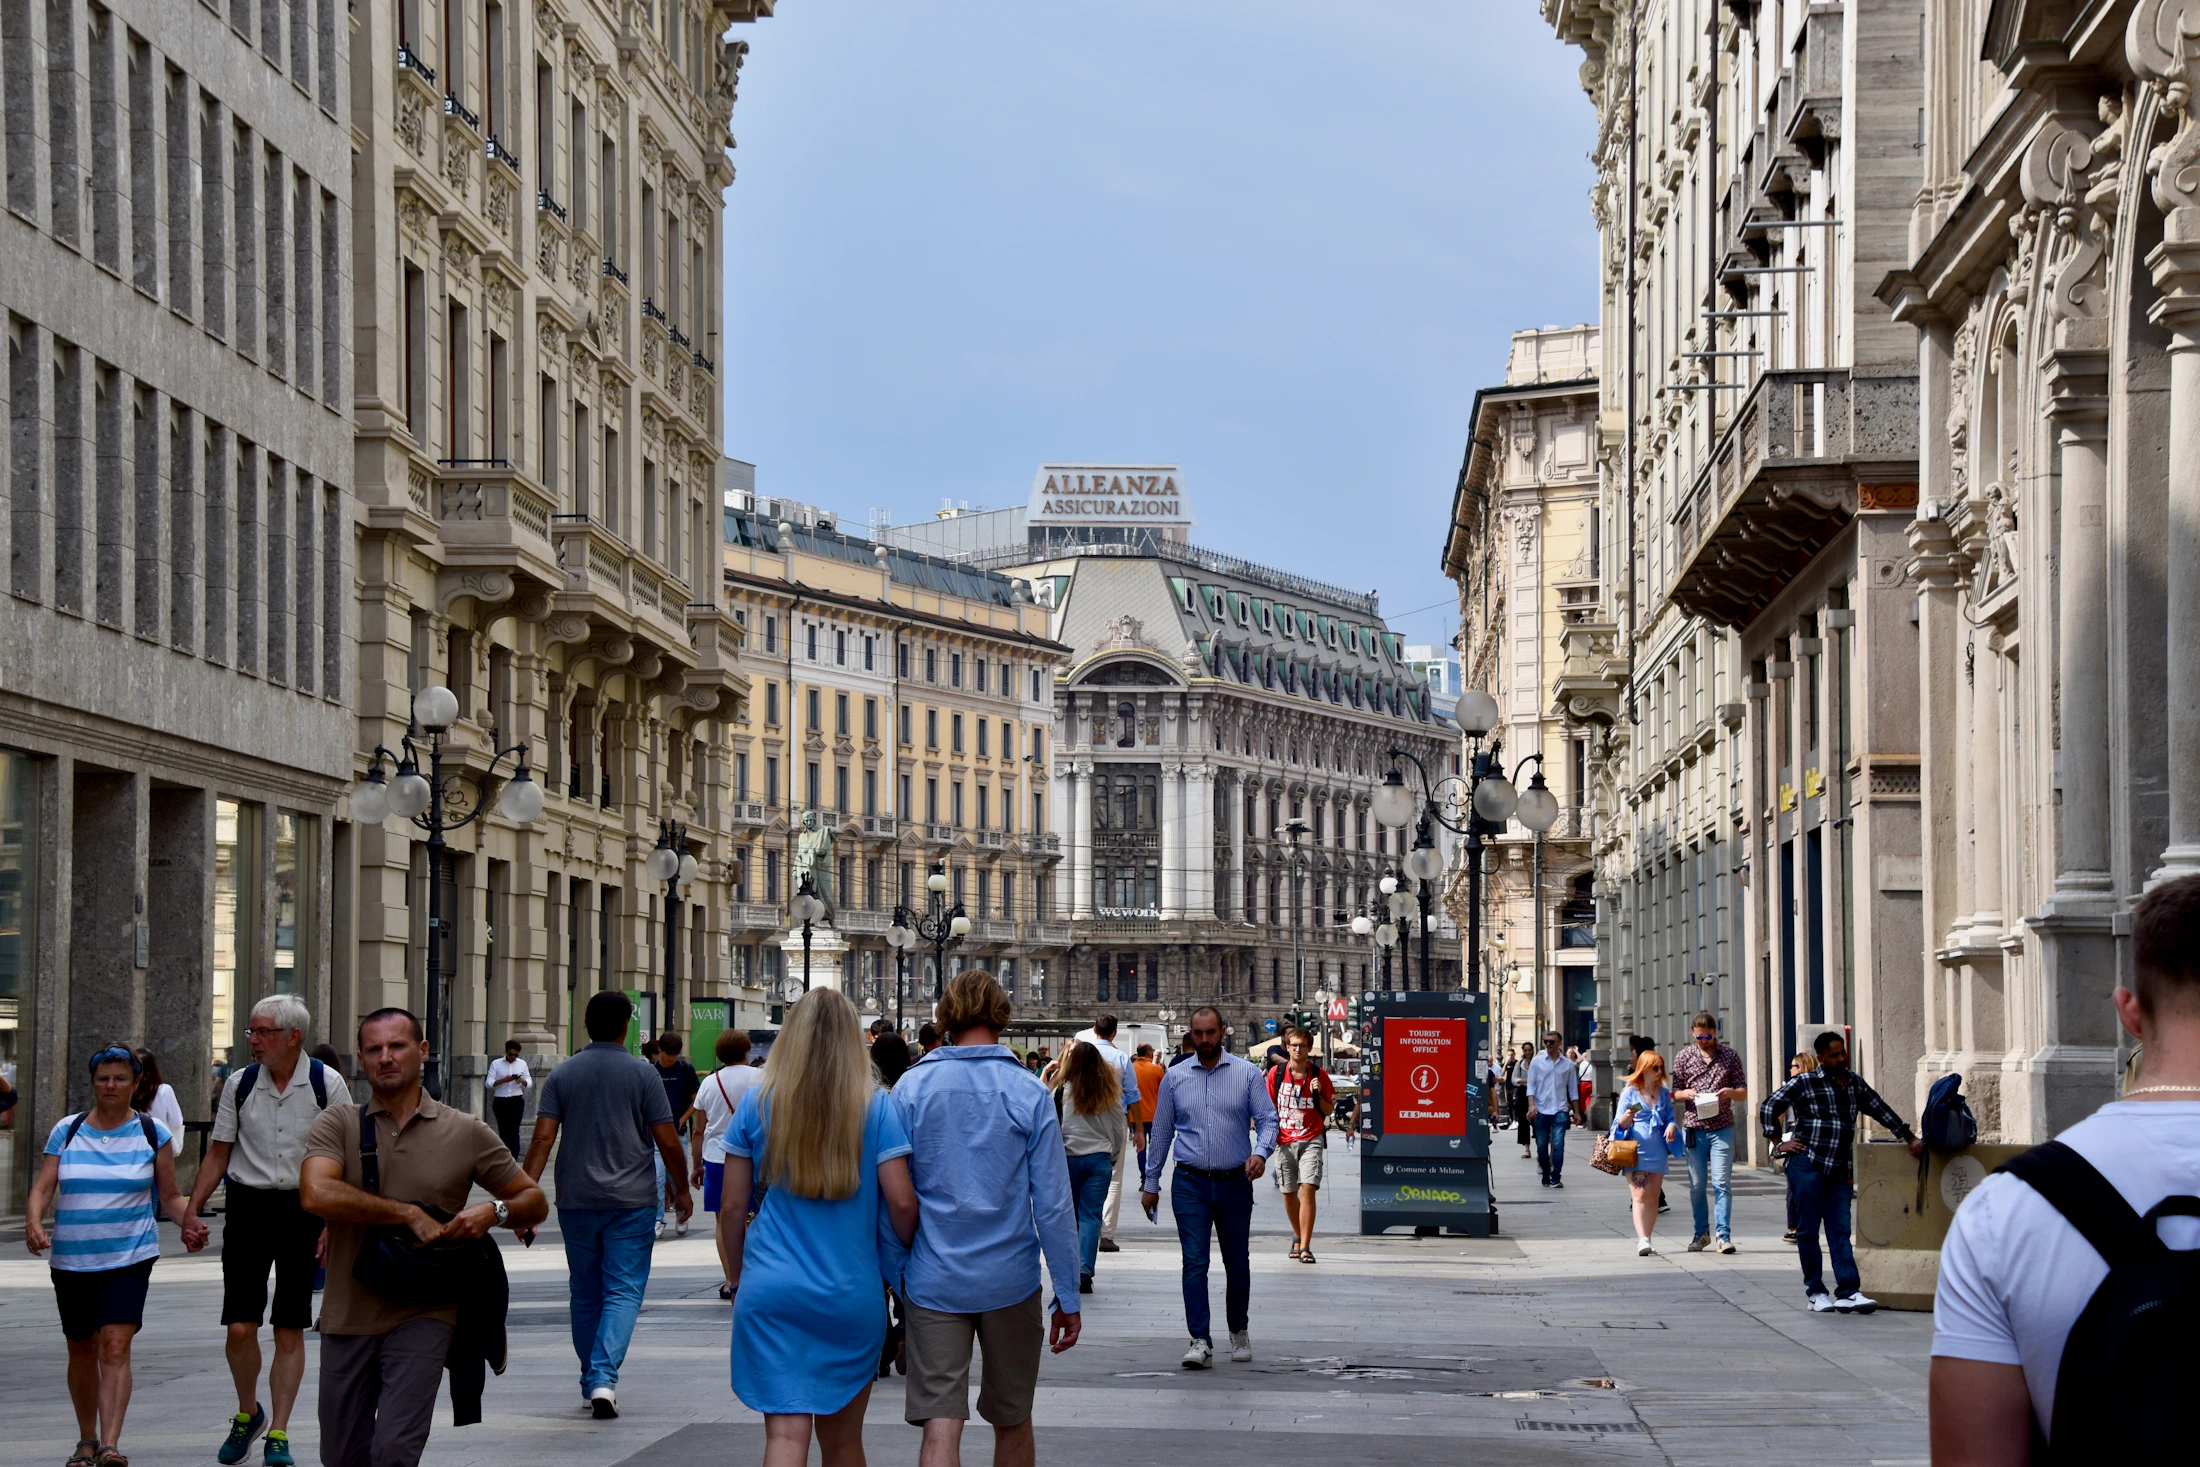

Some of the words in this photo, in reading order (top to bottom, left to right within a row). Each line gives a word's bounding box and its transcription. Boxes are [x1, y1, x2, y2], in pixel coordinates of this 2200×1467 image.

[1042, 474, 1179, 496] ALLEANZA
[1042, 499, 1179, 516] ASSICURAZIONI
[690, 1008, 725, 1020] WAR
[1327, 1002, 1346, 1017] M
[1408, 1029, 1441, 1037] TOURIST
[1399, 1038, 1451, 1046] INFORMATION
[1412, 1046, 1439, 1054] OFFICE
[1396, 1165, 1427, 1174] Comune
[1429, 1166, 1437, 1174] di
[1439, 1166, 1465, 1175] Milano
